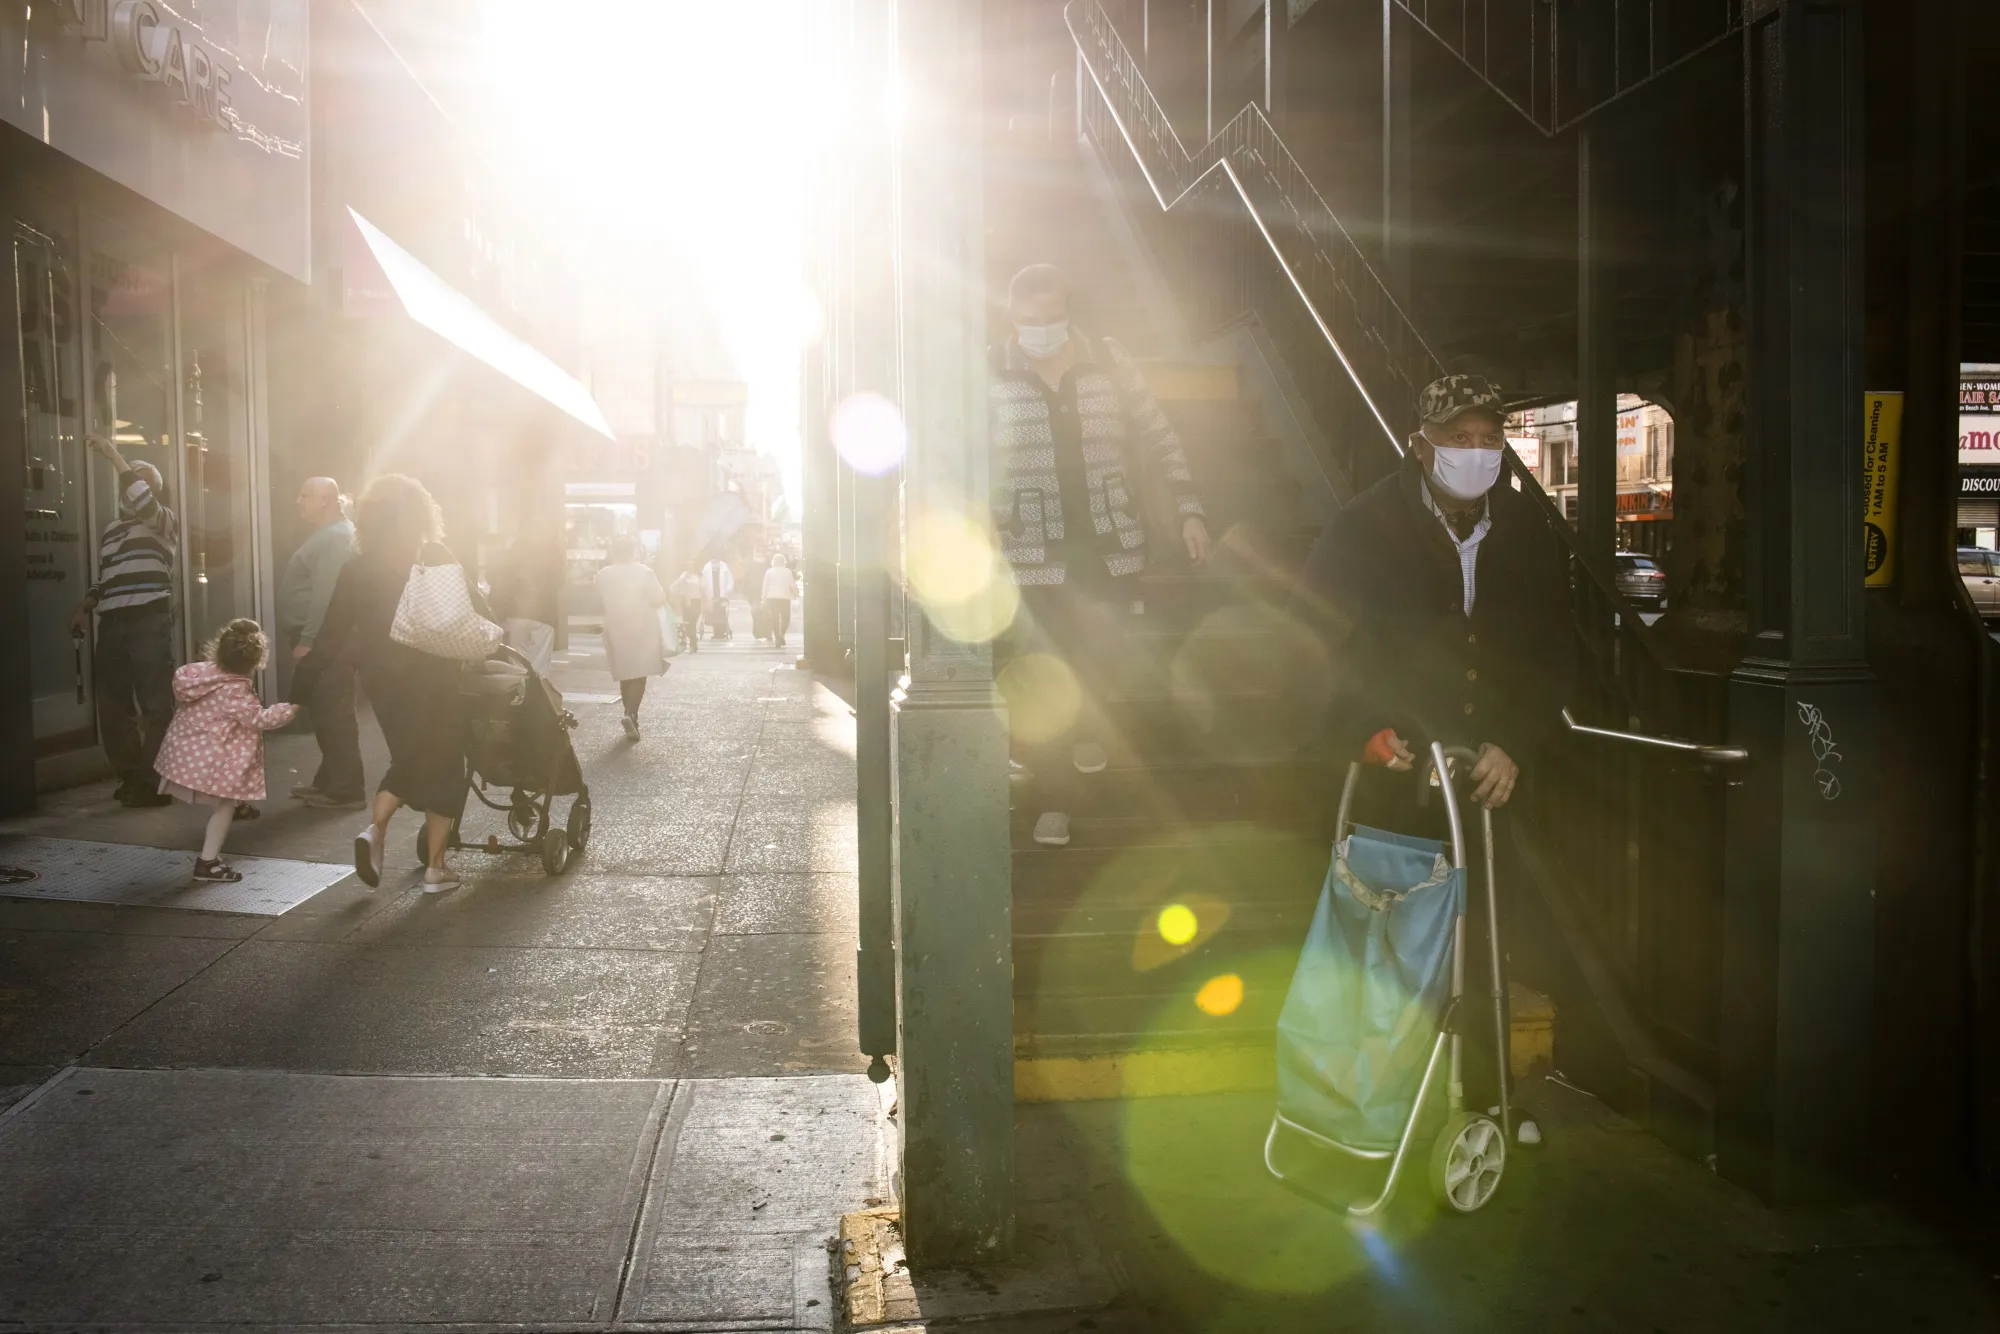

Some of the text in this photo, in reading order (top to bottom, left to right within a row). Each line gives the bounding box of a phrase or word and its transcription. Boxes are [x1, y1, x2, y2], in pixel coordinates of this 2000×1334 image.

[116, 0, 232, 132] CARE
[1866, 400, 1882, 454] Cleaning
[1879, 442, 1889, 463] AM
[1864, 456, 1874, 473] for
[1877, 464, 1886, 473] 5
[1876, 475, 1885, 488] to
[1868, 531, 1880, 570] ENTRY
